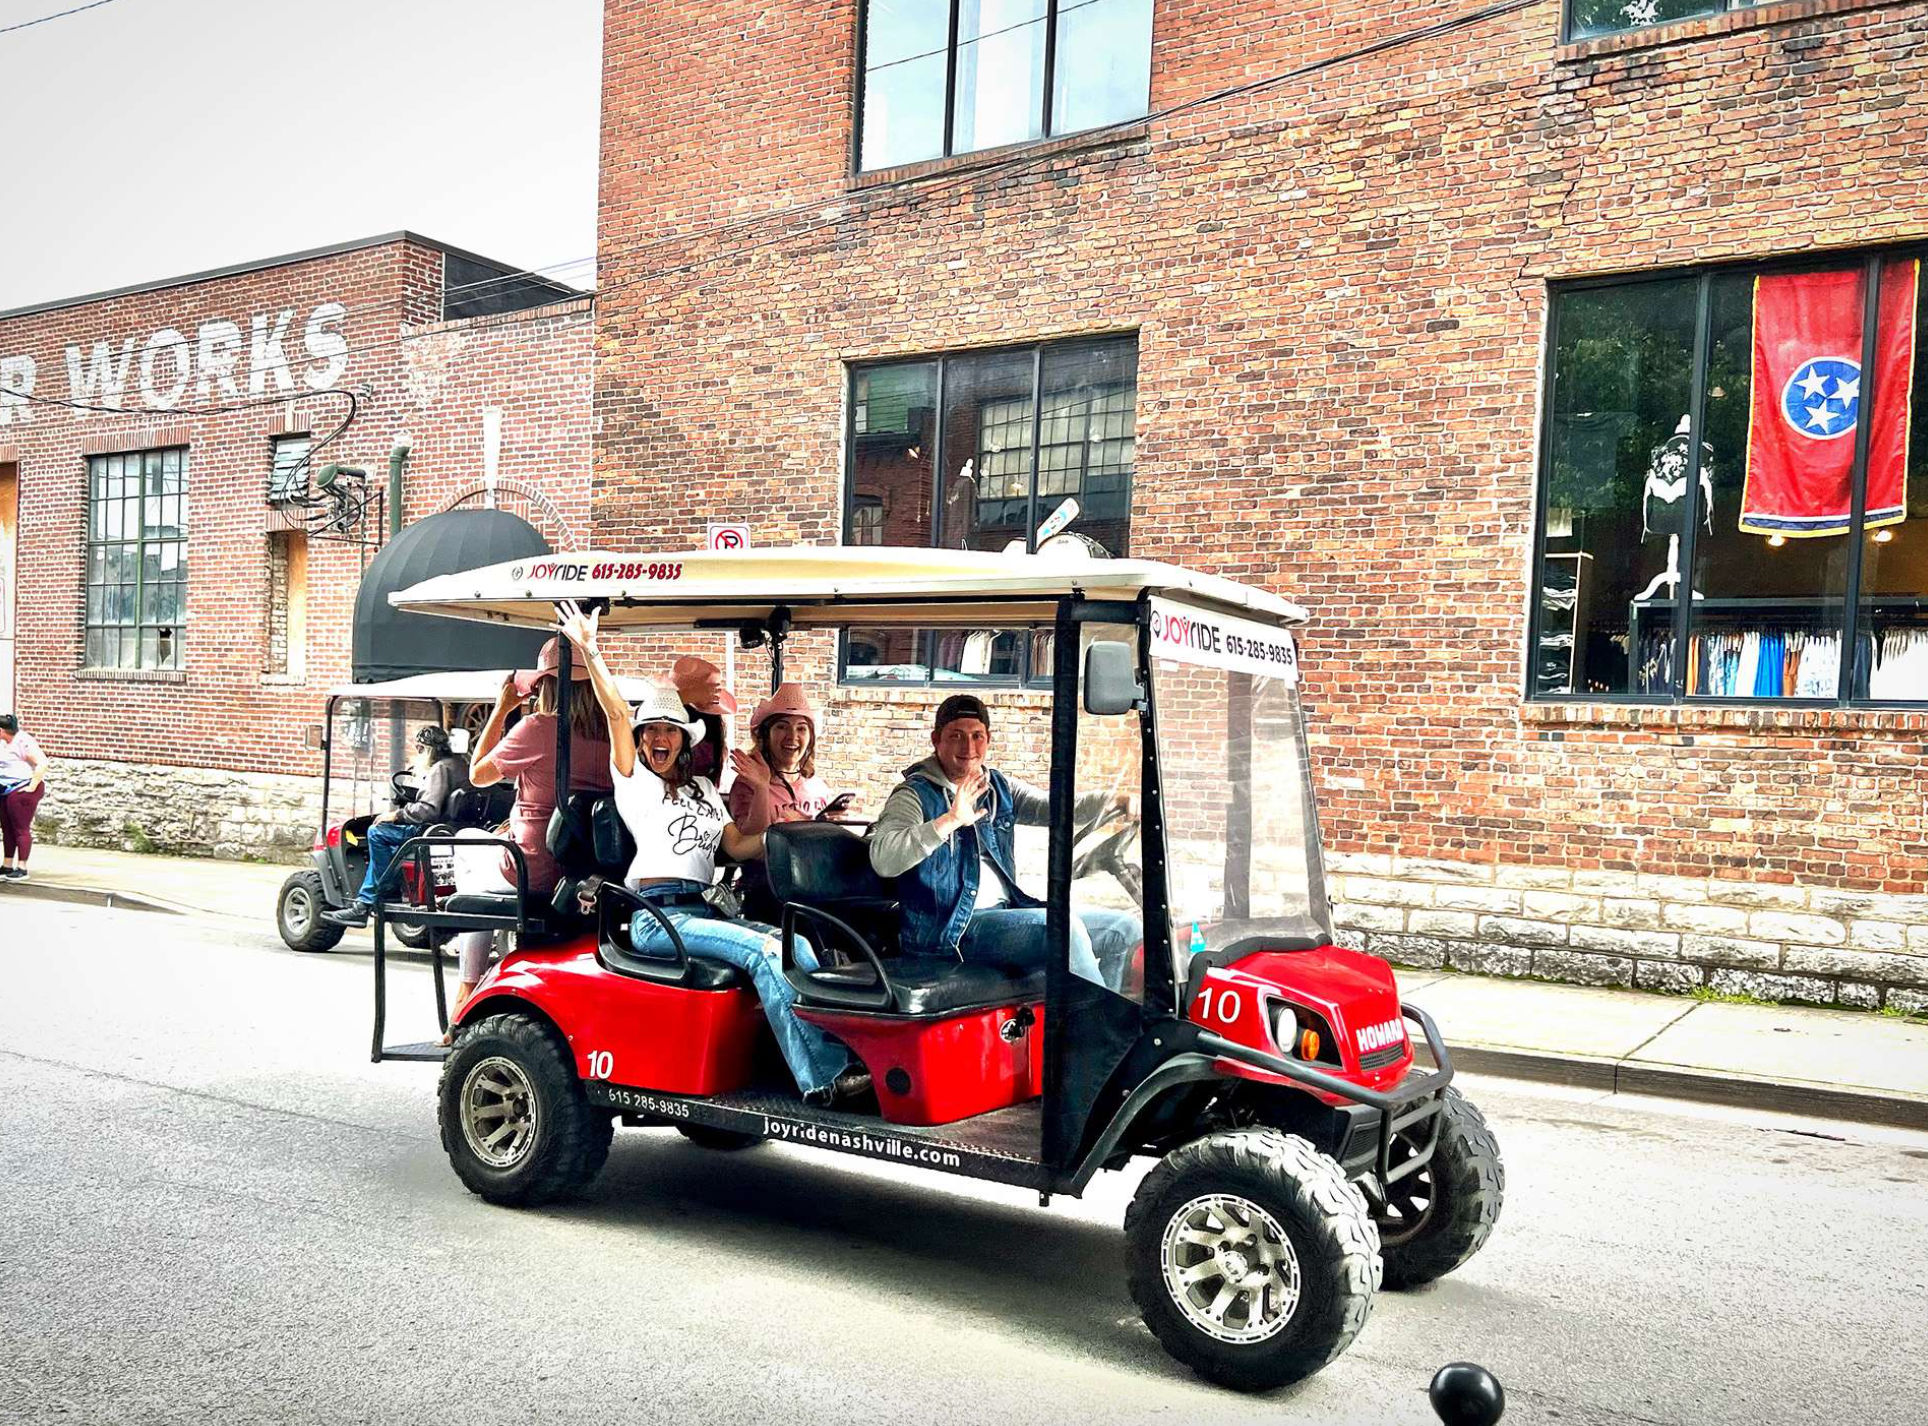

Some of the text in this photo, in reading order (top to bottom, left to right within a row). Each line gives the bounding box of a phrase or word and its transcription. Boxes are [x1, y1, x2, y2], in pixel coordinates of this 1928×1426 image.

[64, 302, 349, 414] WORKS
[591, 562, 682, 580] 615-285-9835
[1226, 634, 1293, 665] 615-285-9835
[1198, 986, 1241, 1023] 10
[587, 1050, 613, 1079] 10
[609, 1088, 689, 1118] 615 285-9835
[763, 1116, 960, 1167] joyridenashville.com
